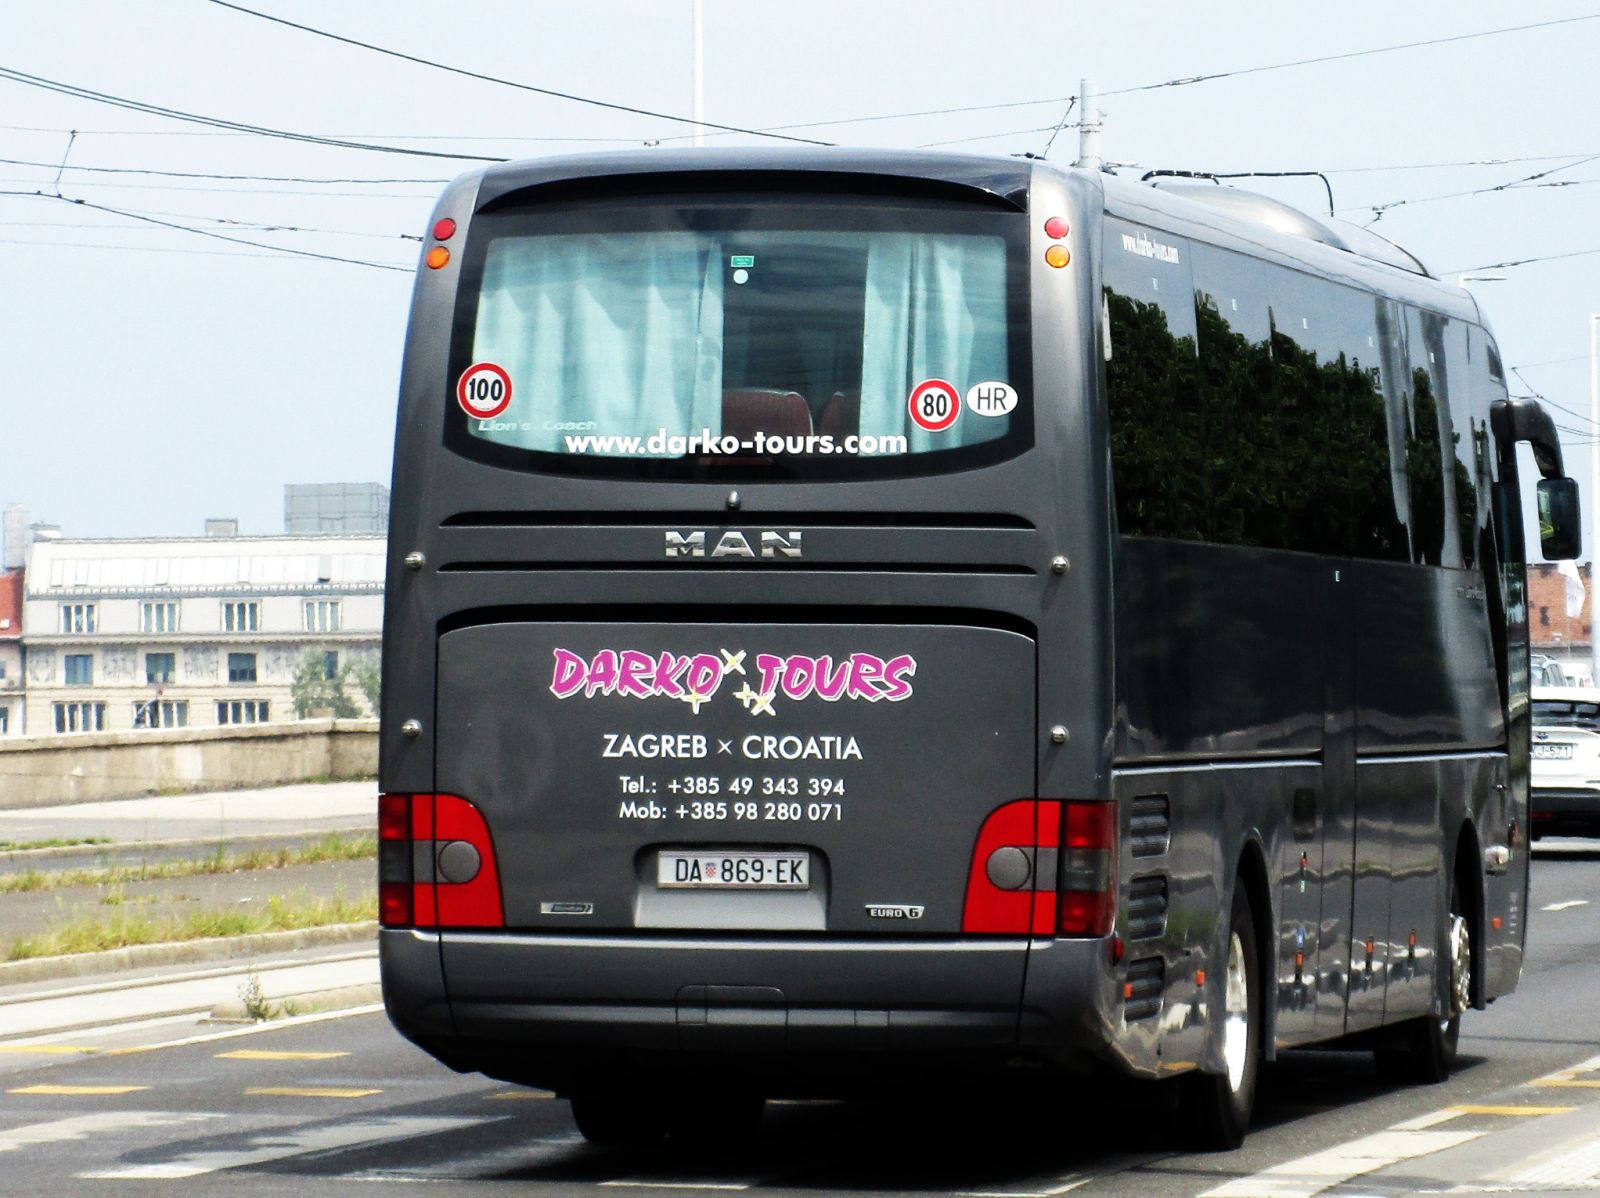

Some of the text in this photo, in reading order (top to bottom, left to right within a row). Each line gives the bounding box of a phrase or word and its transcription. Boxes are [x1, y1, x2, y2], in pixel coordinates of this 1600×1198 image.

[469, 378, 503, 401] 100
[977, 387, 1007, 410] HR
[923, 393, 947, 417] 80
[478, 420, 597, 431] Lion's Coach
[565, 429, 908, 455] www.darko-tours.com
[664, 531, 803, 557] MAN
[550, 648, 917, 702] DARKO TOURS
[602, 734, 863, 760] ZAGREB CROATIA
[619, 776, 845, 796] Tel.: +385 49 343 394
[619, 802, 843, 821] Mob: +385 98 280 071
[676, 858, 803, 883] DA 869-EK
[870, 908, 903, 918] EURO
